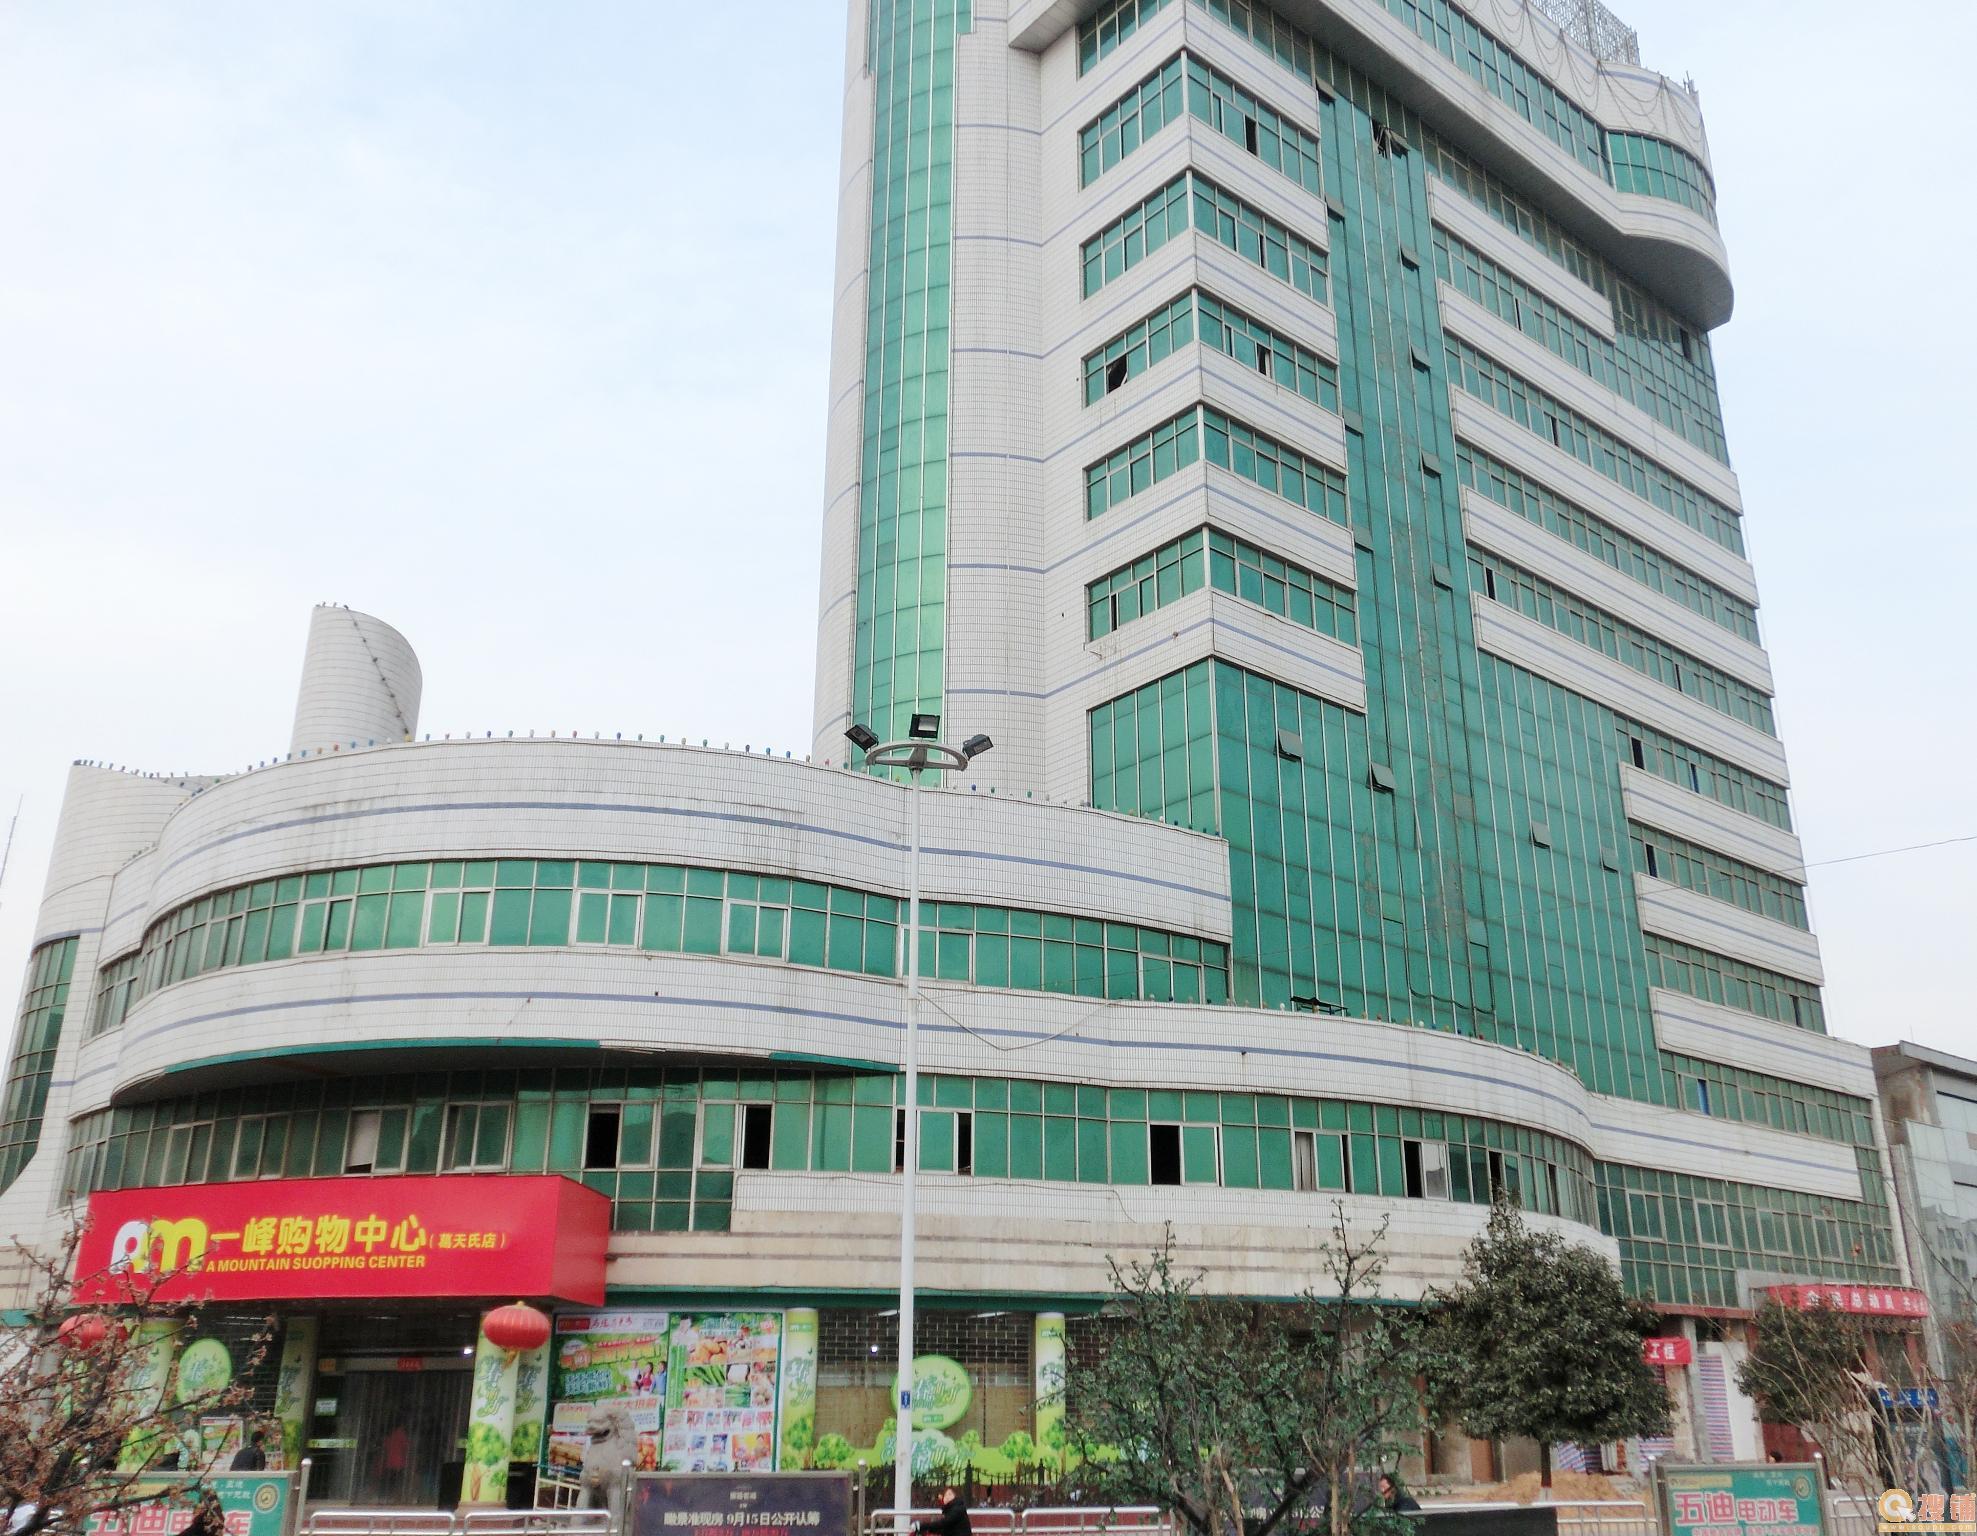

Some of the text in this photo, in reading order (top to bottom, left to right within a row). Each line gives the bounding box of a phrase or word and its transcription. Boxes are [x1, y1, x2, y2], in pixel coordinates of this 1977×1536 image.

[210, 1214, 426, 1256] 一峰购物中心
[206, 1255, 425, 1272] A MOUNTAIN SUOPPING CENTER
[1674, 1491, 1798, 1525] 五迪电动车
